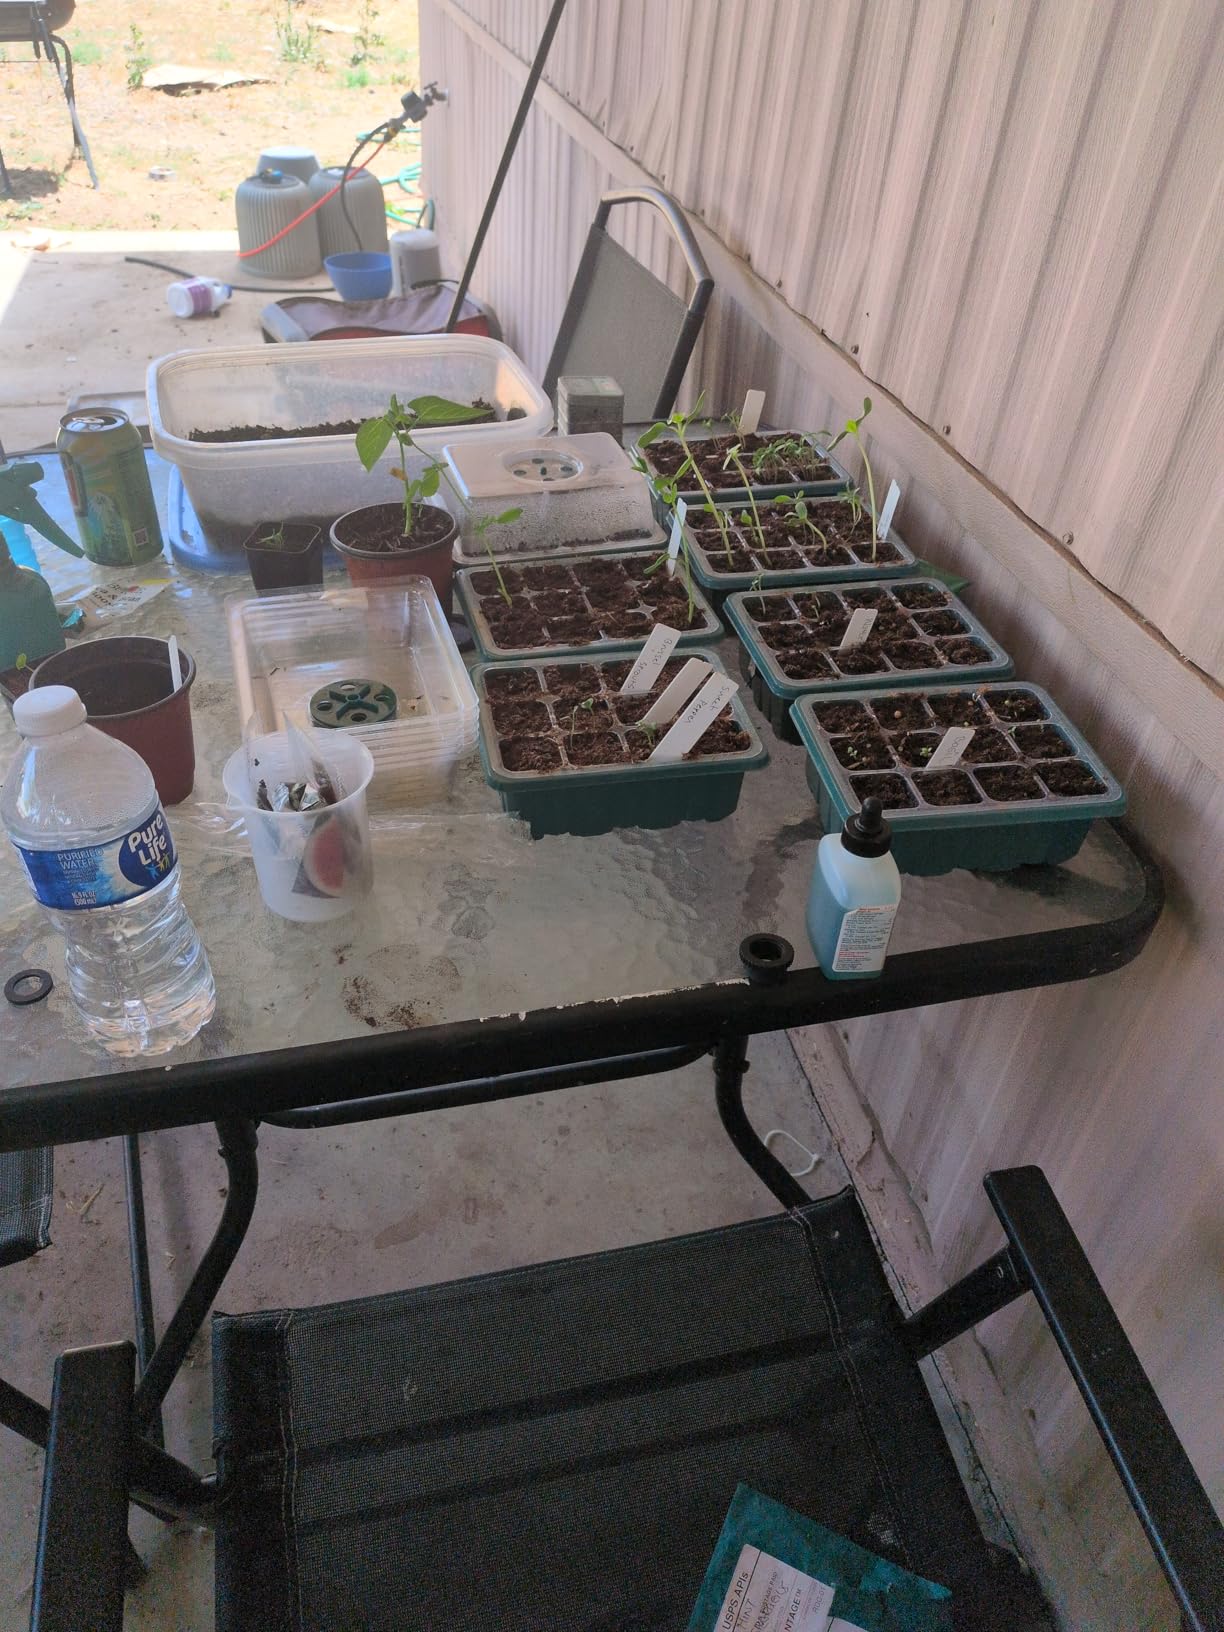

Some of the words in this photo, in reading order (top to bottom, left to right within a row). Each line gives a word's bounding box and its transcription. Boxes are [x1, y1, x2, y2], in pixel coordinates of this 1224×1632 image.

[128, 814, 164, 853] Pure
[138, 834, 167, 865] Life
[722, 1598, 739, 1630] USPS
[734, 1571, 749, 1598] APIs
